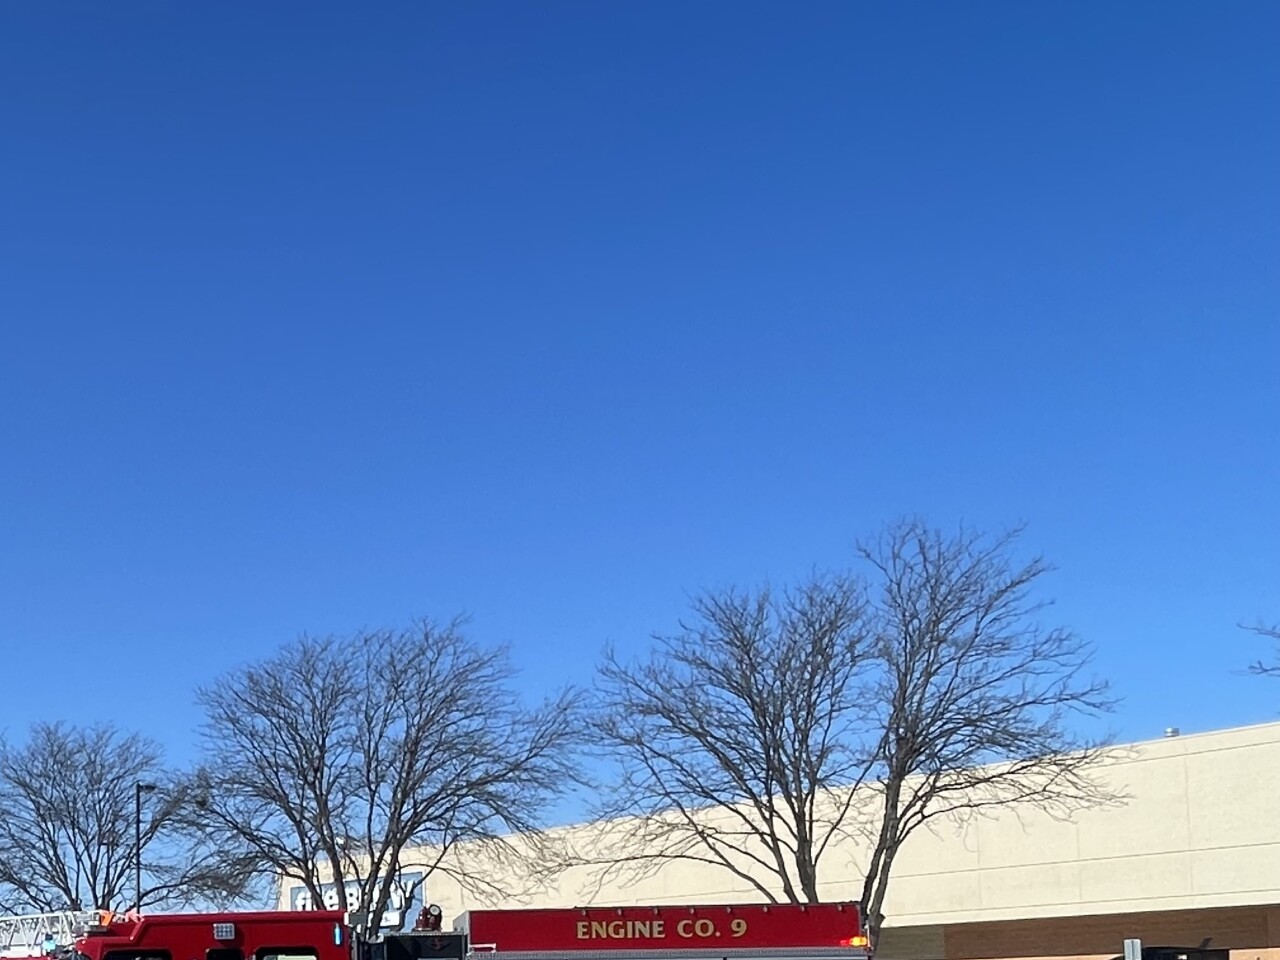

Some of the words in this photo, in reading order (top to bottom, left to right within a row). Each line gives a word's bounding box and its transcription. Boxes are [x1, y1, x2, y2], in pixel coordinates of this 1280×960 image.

[294, 886, 340, 911] fie
[576, 920, 666, 939] ENGINE
[677, 919, 721, 938] CO.
[730, 919, 747, 937] 9
